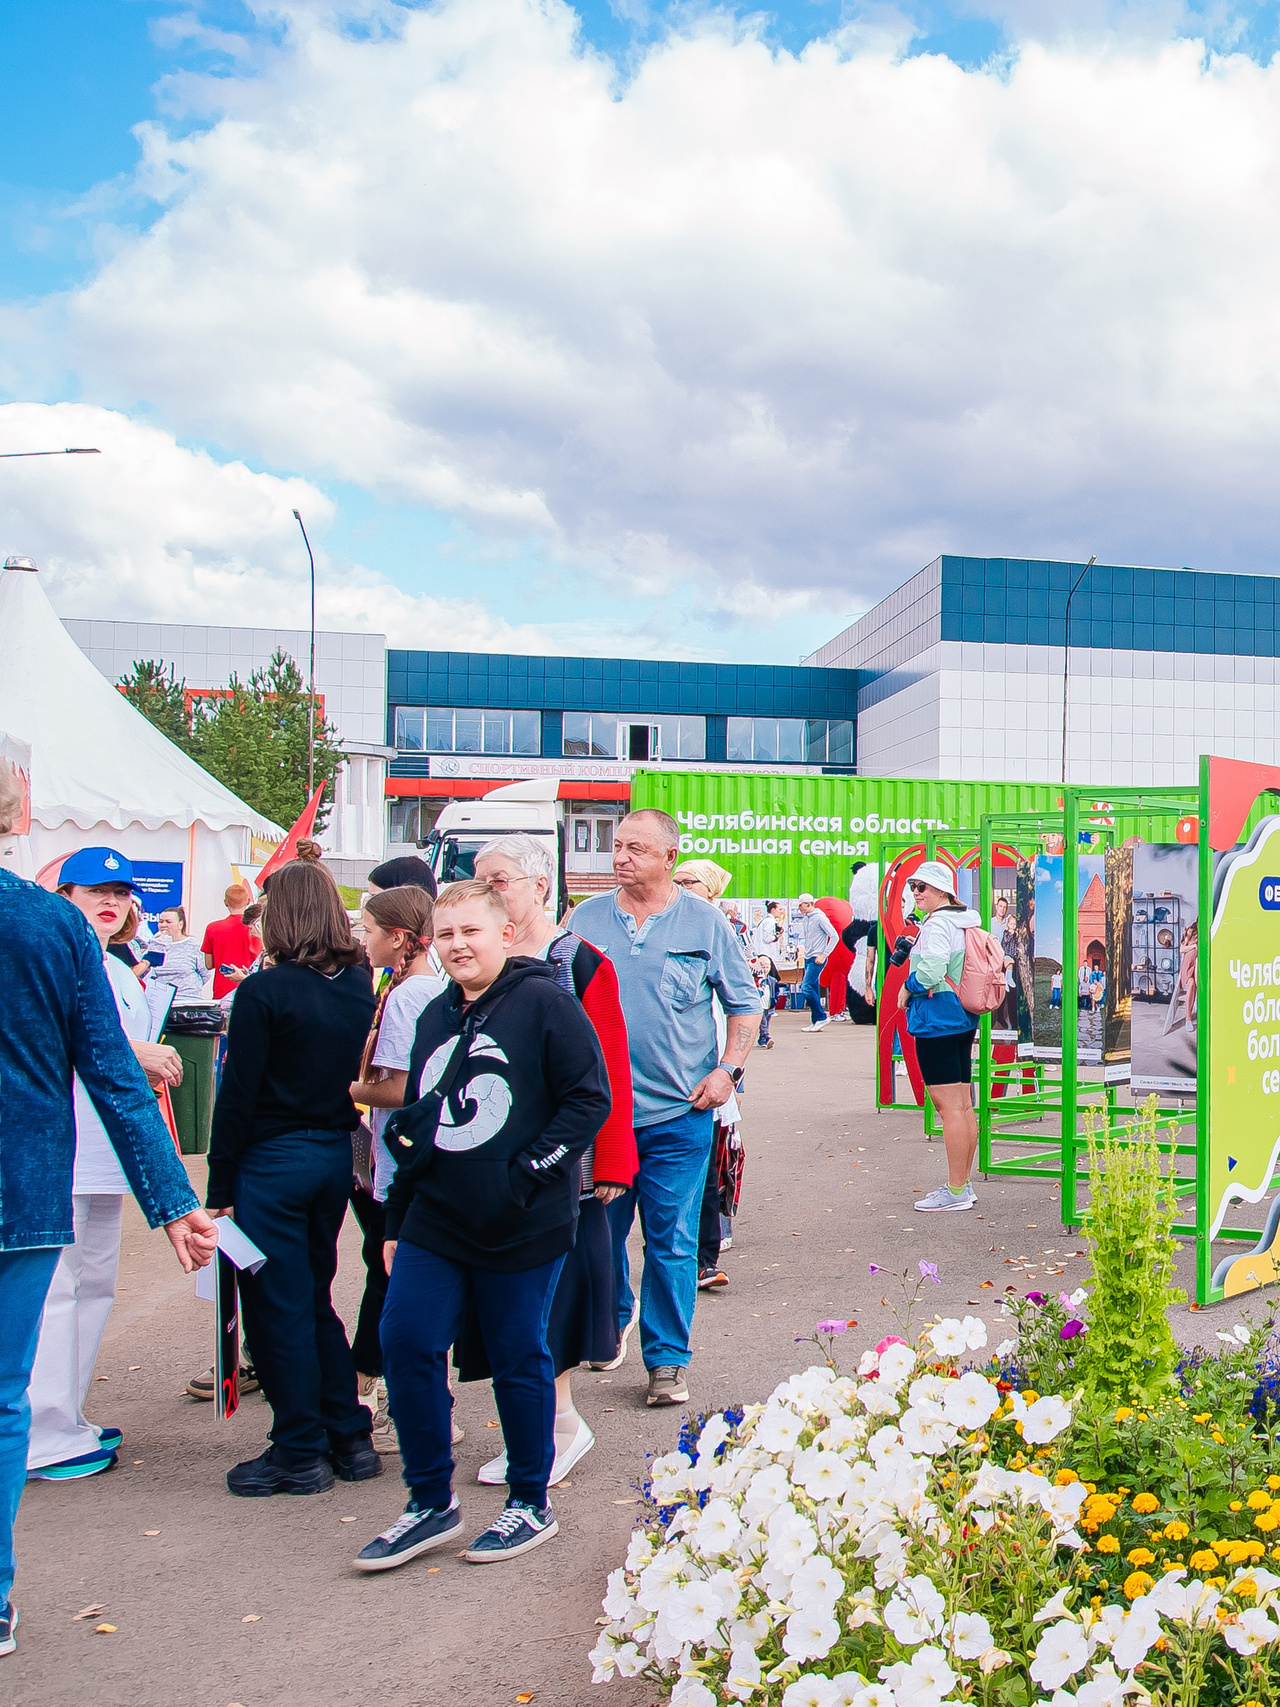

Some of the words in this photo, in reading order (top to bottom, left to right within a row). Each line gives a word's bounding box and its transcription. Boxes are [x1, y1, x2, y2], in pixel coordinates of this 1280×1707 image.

[468, 762, 577, 776] СПОРТИВНЫЙ
[578, 765, 662, 778] КОМПЛ
[676, 810, 843, 833] Челябинская
[850, 814, 950, 834] область
[678, 833, 792, 855] большая
[799, 838, 869, 857] семья
